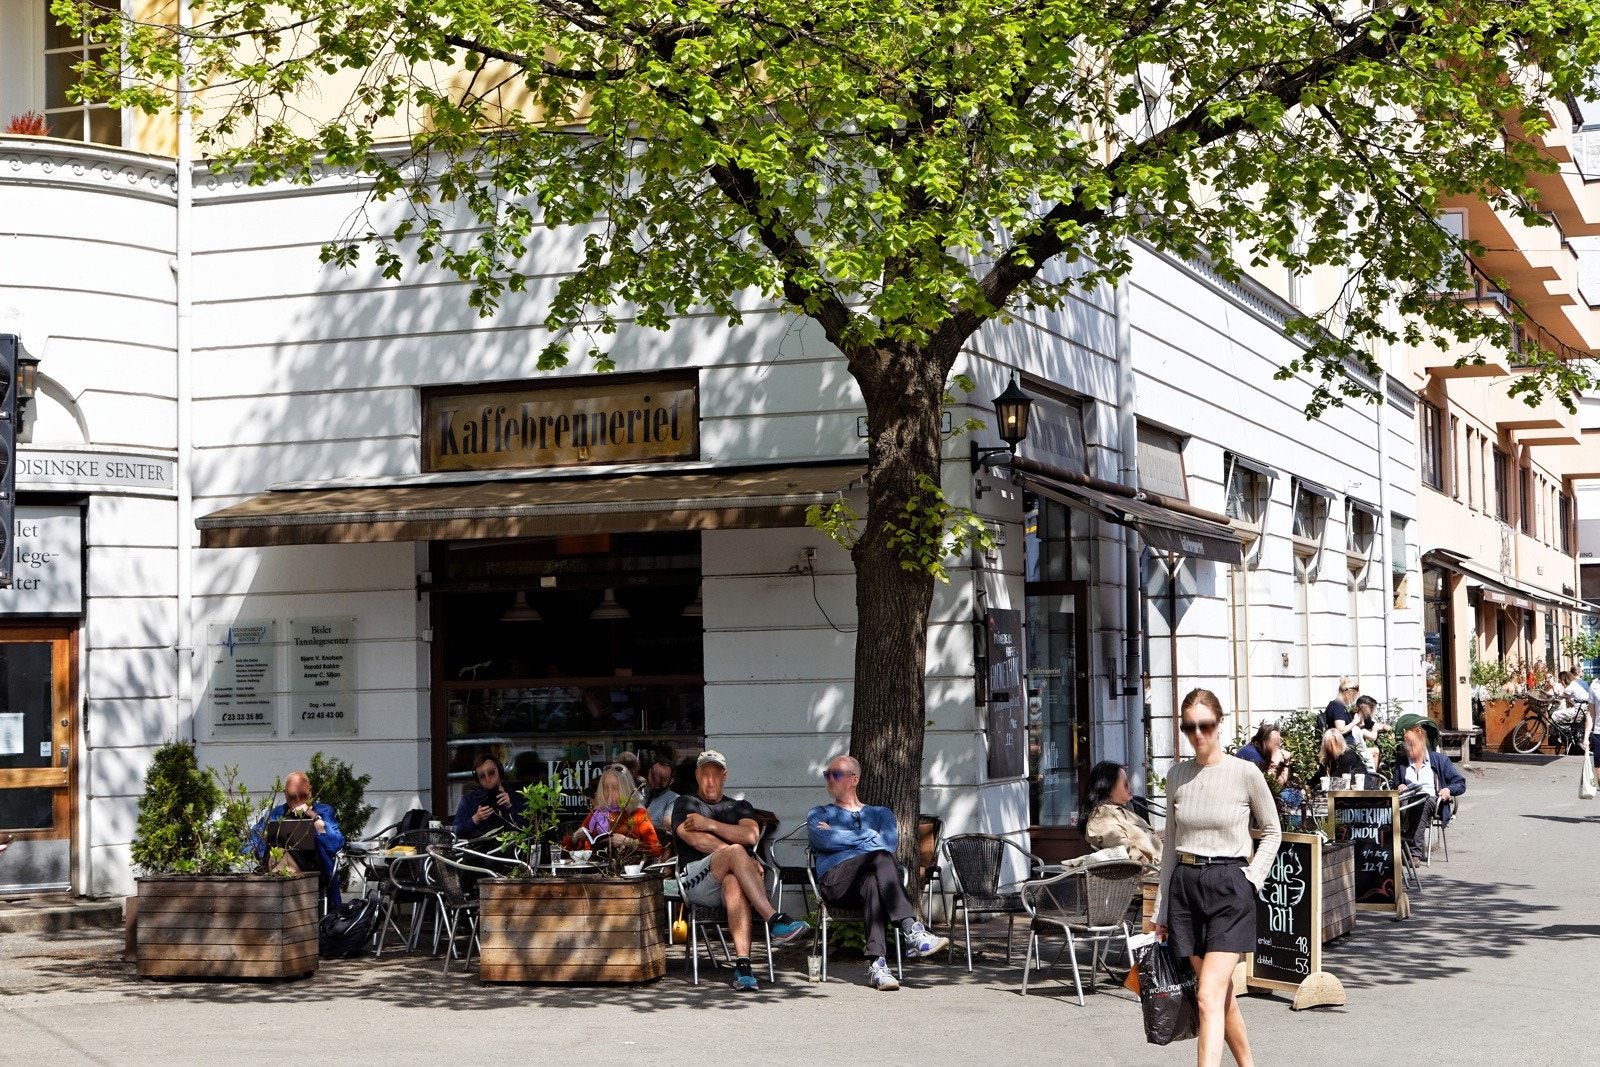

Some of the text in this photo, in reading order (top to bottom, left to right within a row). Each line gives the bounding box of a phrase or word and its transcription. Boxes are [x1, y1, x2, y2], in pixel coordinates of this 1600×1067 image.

[439, 395, 684, 456] Kaffebrenneriet
[105, 462, 165, 481] SENTER
[14, 521, 39, 538] let
[311, 626, 332, 634] Bislet
[294, 637, 349, 647] Tannlegesenter
[227, 712, 264, 721] 23 33 35 80
[316, 711, 325, 719] 45
[325, 711, 334, 719] 43
[1270, 883, 1288, 908] au
[1257, 936, 1273, 946] enkel
[1256, 954, 1273, 966] dobbel
